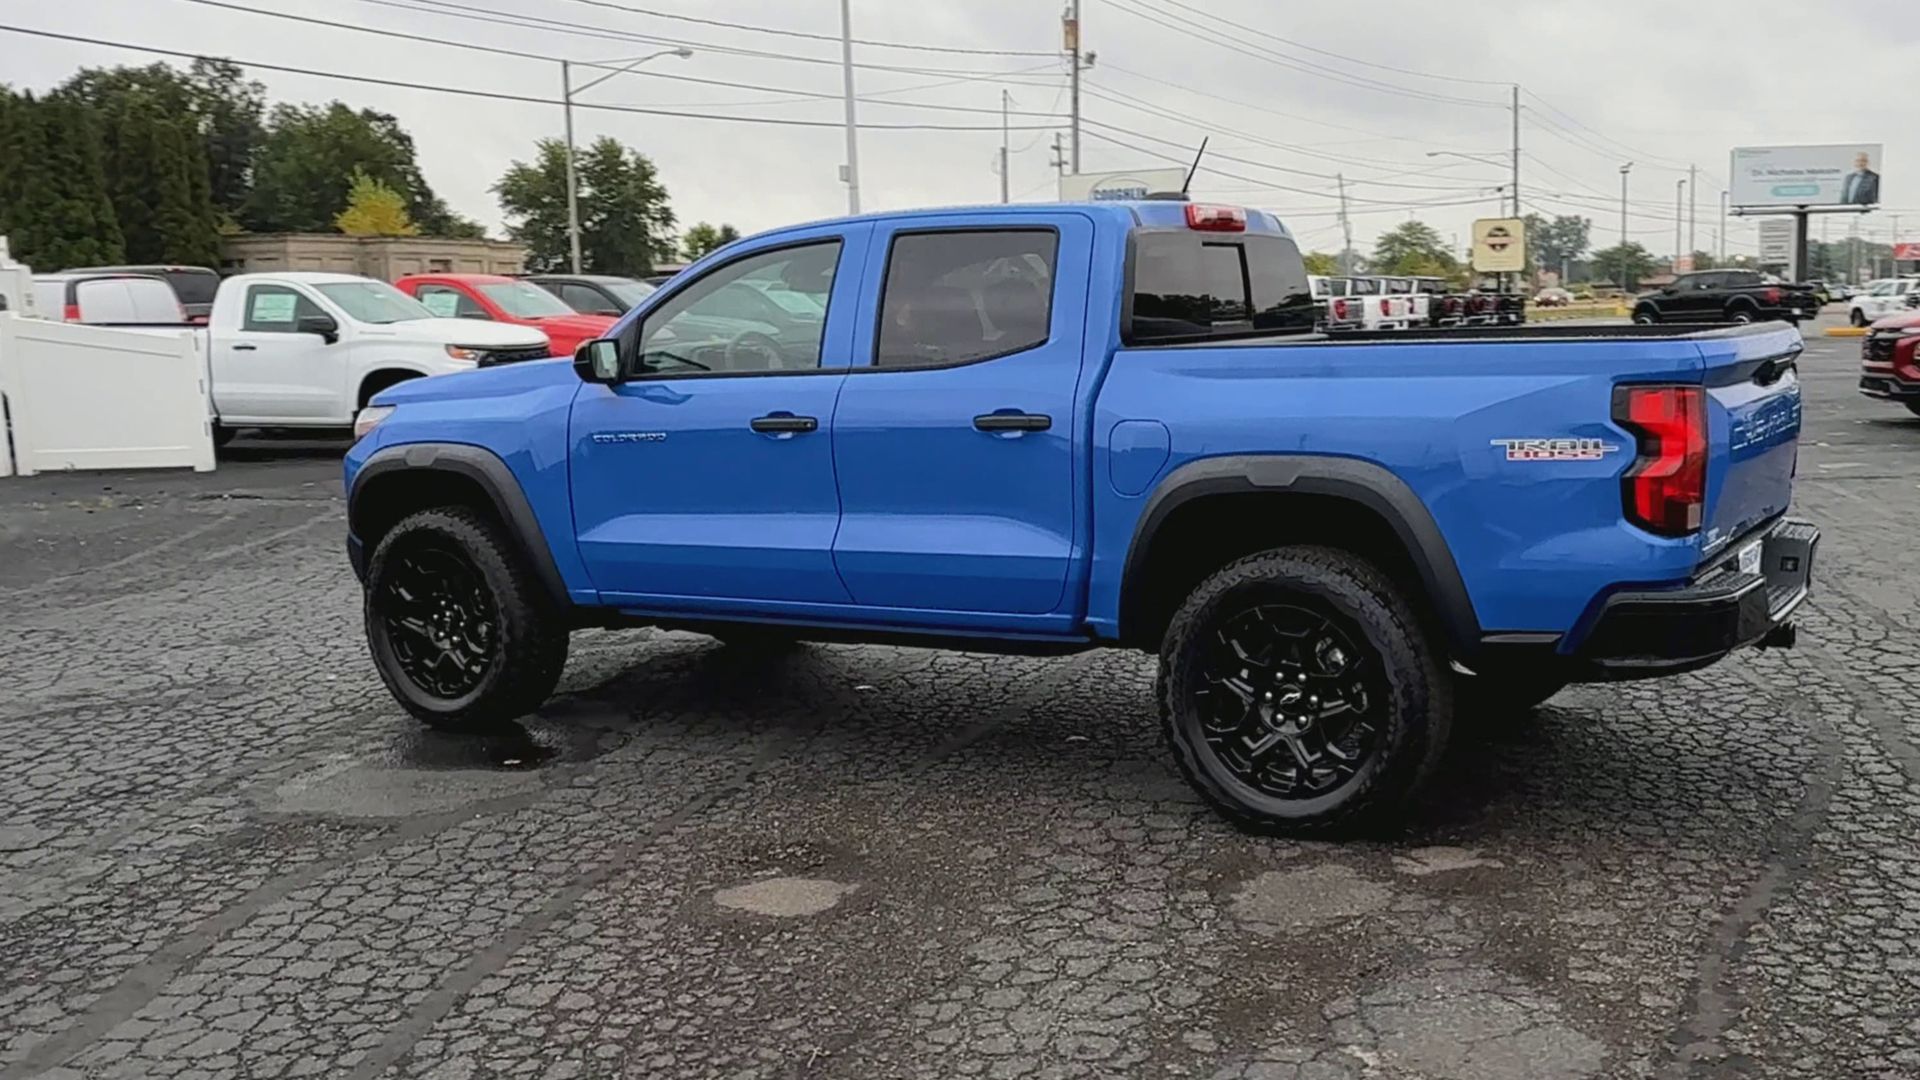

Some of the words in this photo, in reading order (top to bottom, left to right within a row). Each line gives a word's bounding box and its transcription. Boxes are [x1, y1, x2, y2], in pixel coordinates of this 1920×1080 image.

[592, 432, 667, 443] COLORADO
[1490, 438, 1620, 452] TRAIL
[1507, 450, 1604, 461] BOSS
